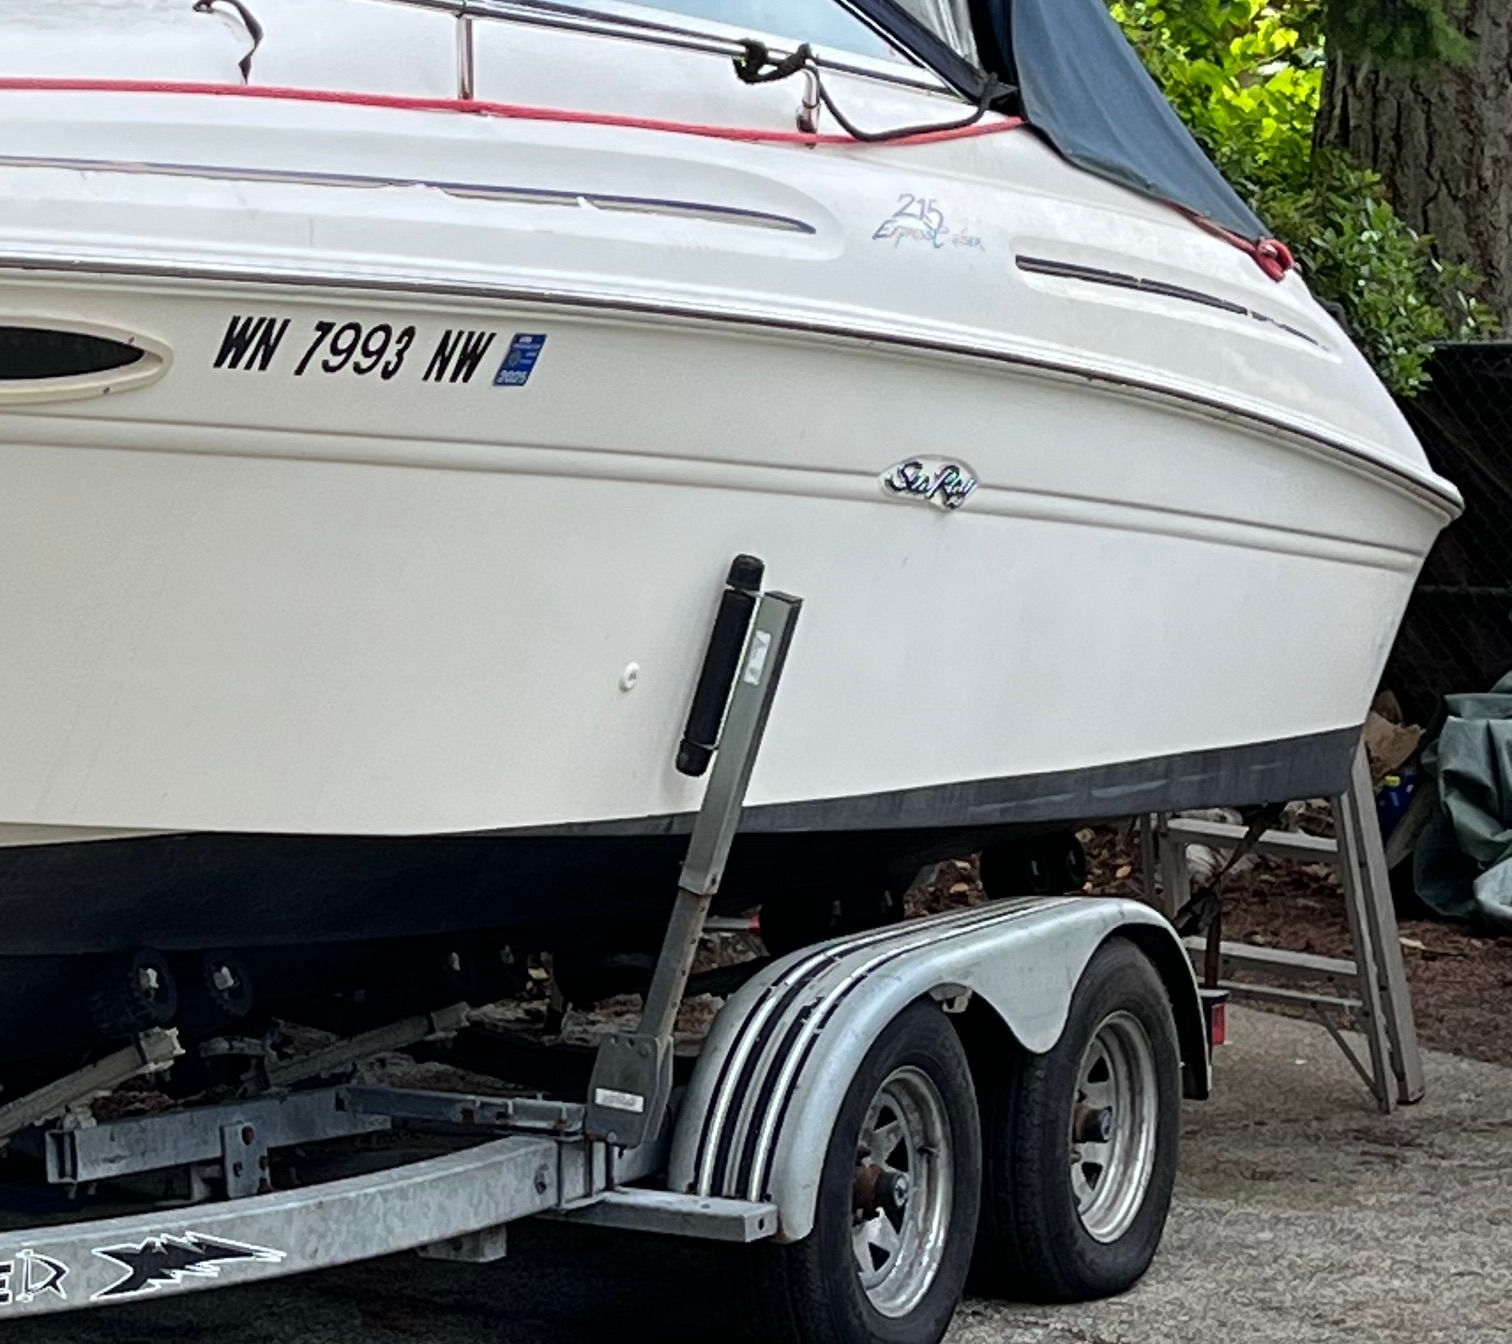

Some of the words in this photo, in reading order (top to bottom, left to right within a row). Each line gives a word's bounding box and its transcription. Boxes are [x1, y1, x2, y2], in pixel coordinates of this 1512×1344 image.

[212, 315, 291, 372] WN
[293, 320, 416, 381] 7993
[422, 329, 497, 384] NW
